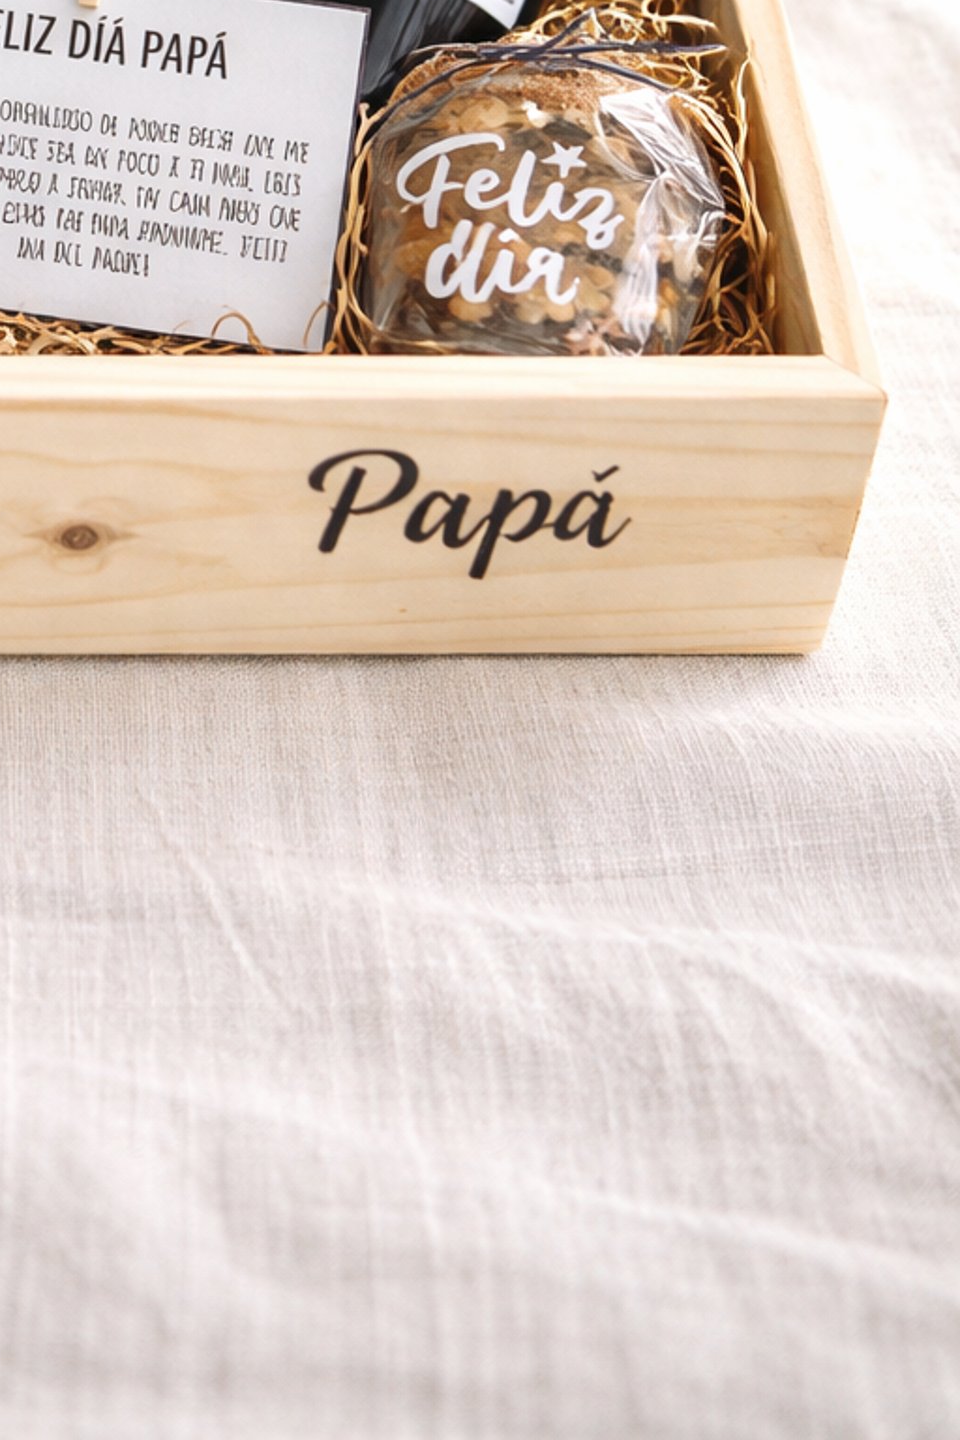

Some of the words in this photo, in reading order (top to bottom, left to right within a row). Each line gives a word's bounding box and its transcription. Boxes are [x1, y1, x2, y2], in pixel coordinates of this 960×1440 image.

[140, 30, 228, 80] PAPÁ
[396, 132, 625, 251] Feliz
[307, 448, 633, 581] Papá
